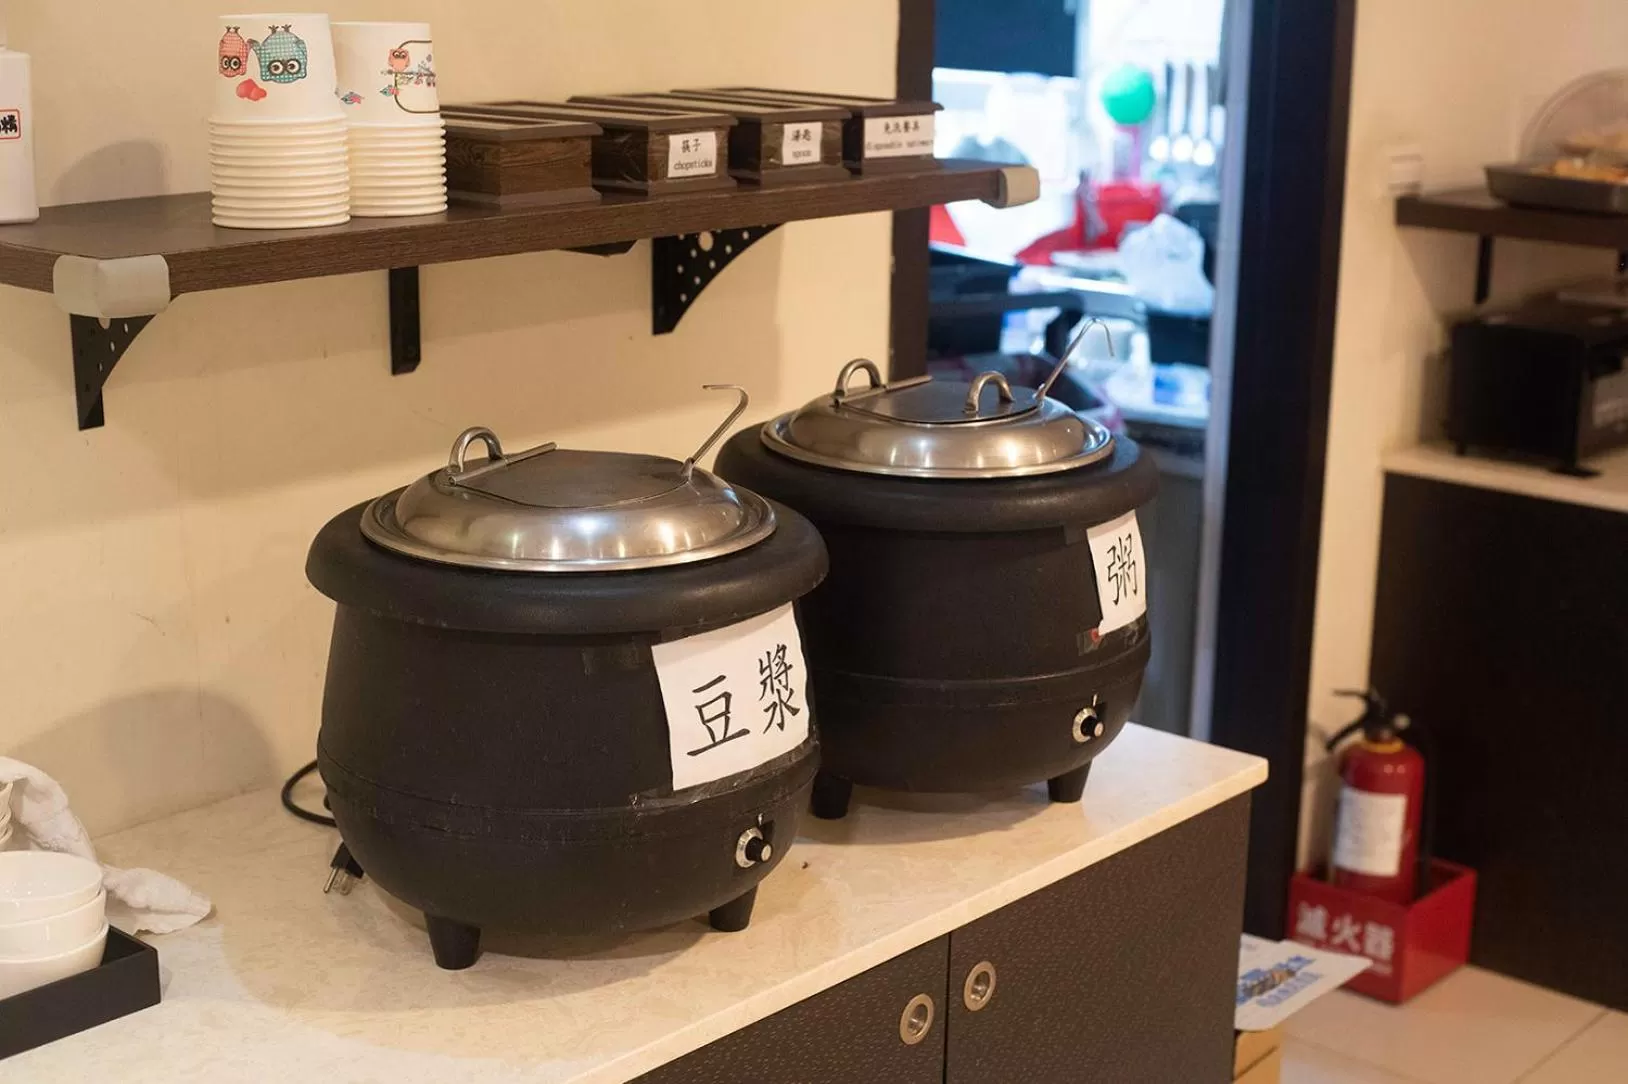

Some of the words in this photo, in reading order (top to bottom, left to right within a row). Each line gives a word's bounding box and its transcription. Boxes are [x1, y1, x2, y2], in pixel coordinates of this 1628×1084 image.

[673, 160, 713, 171] chopsticks
[1107, 532, 1138, 606] 粥
[686, 643, 801, 757] 豆漿
